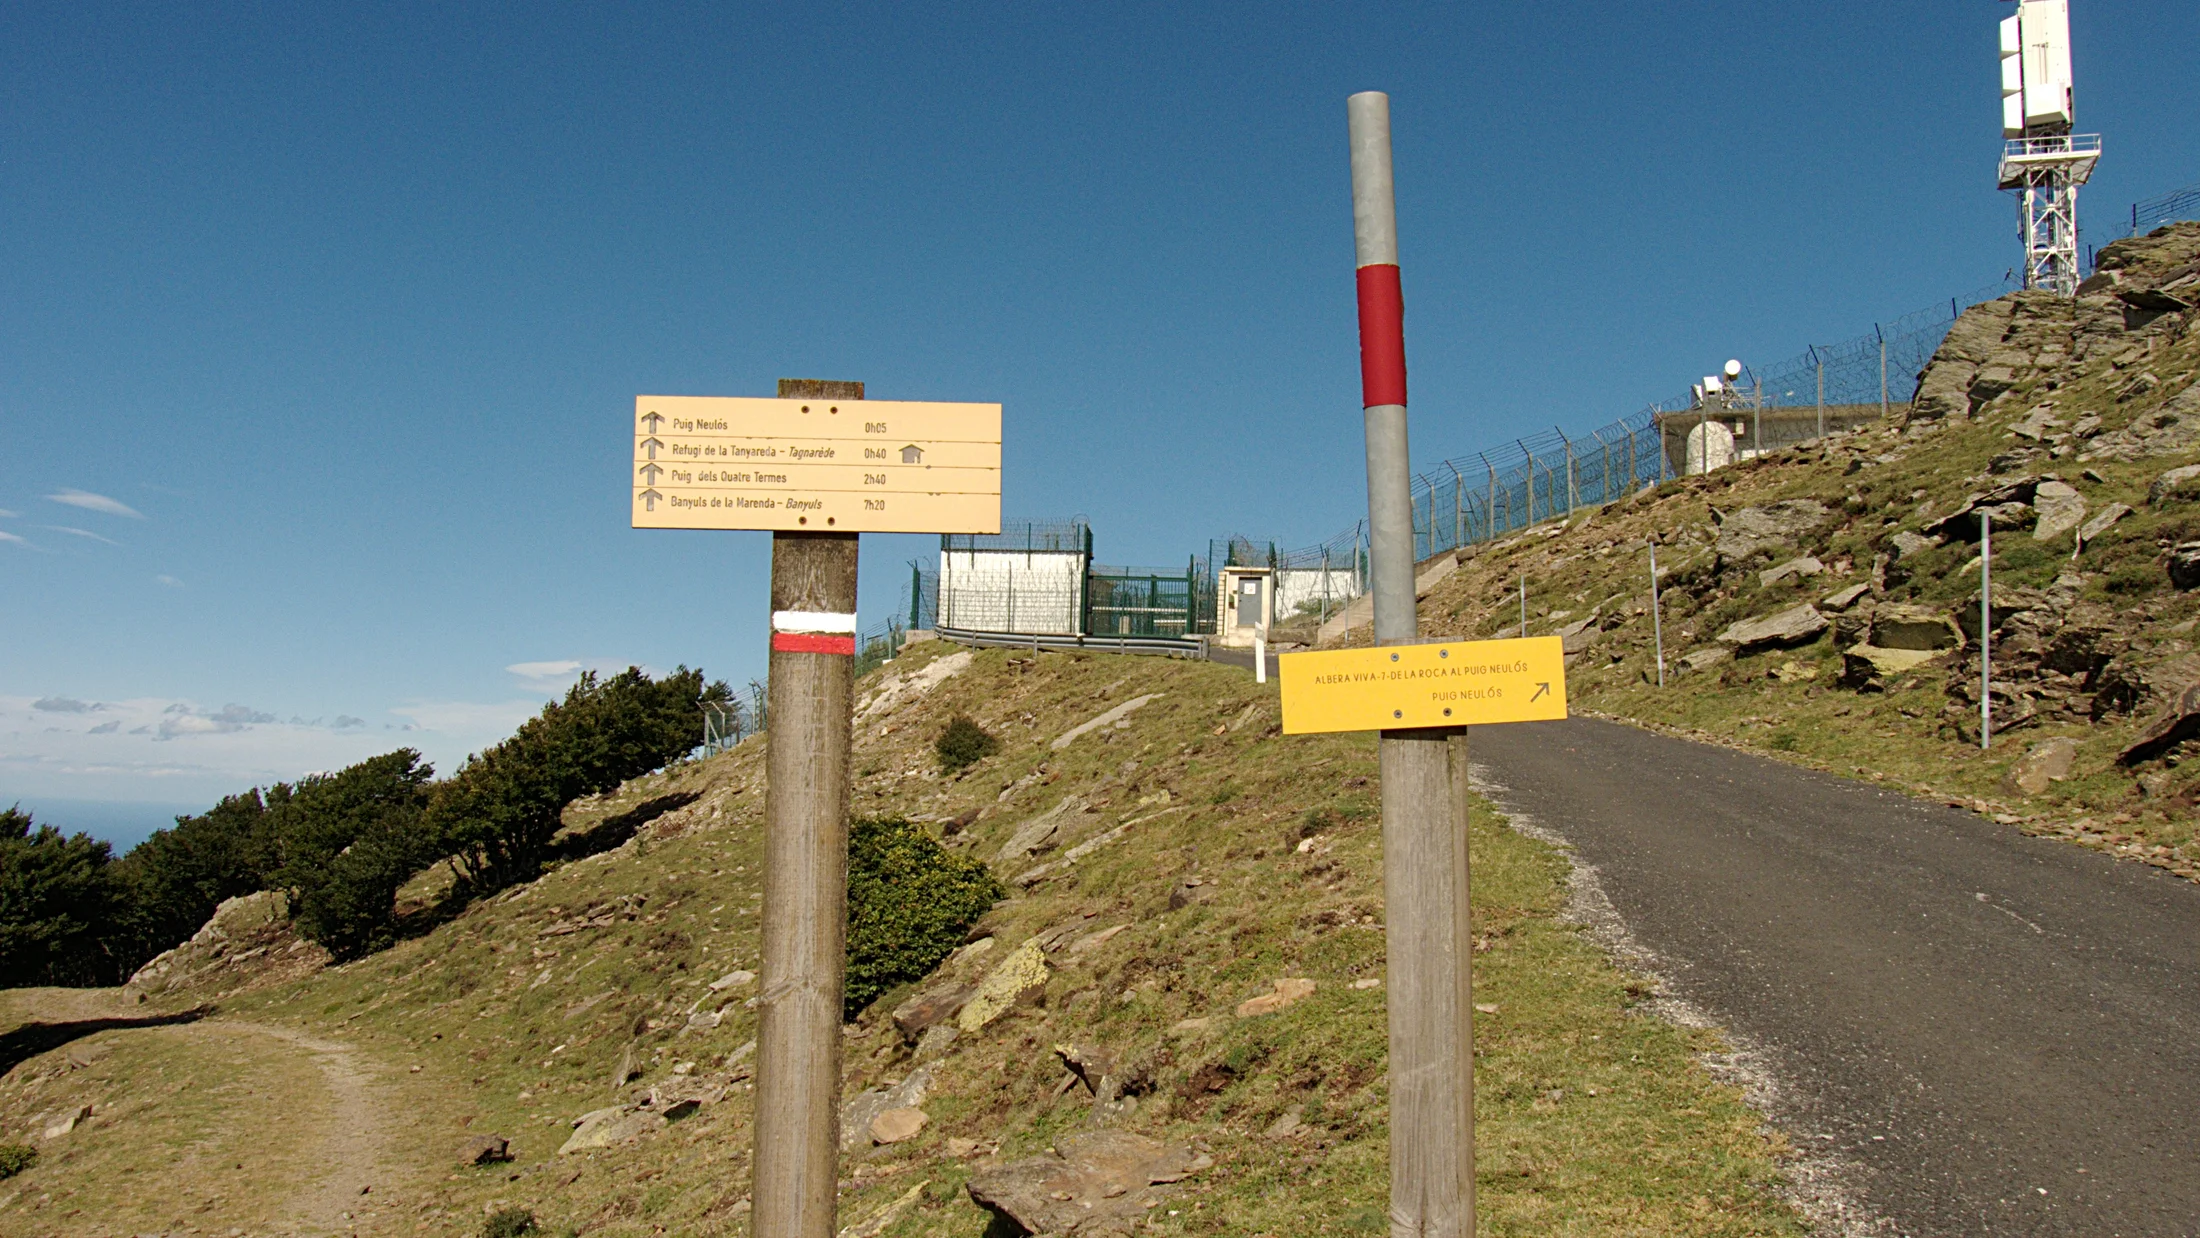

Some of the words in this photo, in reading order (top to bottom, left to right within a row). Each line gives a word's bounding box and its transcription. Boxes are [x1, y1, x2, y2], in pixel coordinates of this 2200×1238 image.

[673, 418, 693, 432] Puig
[696, 418, 728, 430] Neulós
[864, 422, 887, 433] 0h05
[672, 443, 701, 458] Refugi
[704, 445, 716, 455] de
[719, 445, 727, 456] la
[730, 445, 776, 459] Tanyareda
[864, 448, 887, 459] 0h40
[671, 469, 691, 484] Puig
[698, 470, 718, 482] dels
[720, 471, 751, 482] Quatre
[753, 471, 787, 483] Termes
[864, 473, 886, 485] 2h40
[670, 495, 707, 510] Banyuls
[710, 496, 722, 507] de
[724, 497, 733, 508] la
[736, 497, 775, 508] Marenda
[785, 498, 823, 512] Banyuls
[863, 499, 885, 511] 7h20
[1315, 674, 1351, 684] ALBERA
[1404, 670, 1416, 679] LA
[1419, 668, 1447, 678] ROCA
[1450, 667, 1462, 676] AL
[1464, 665, 1487, 675] PUIG
[1489, 660, 1528, 674] NEULÓS
[1432, 691, 1457, 701] PUIG
[1460, 686, 1502, 700] NEULÓS
